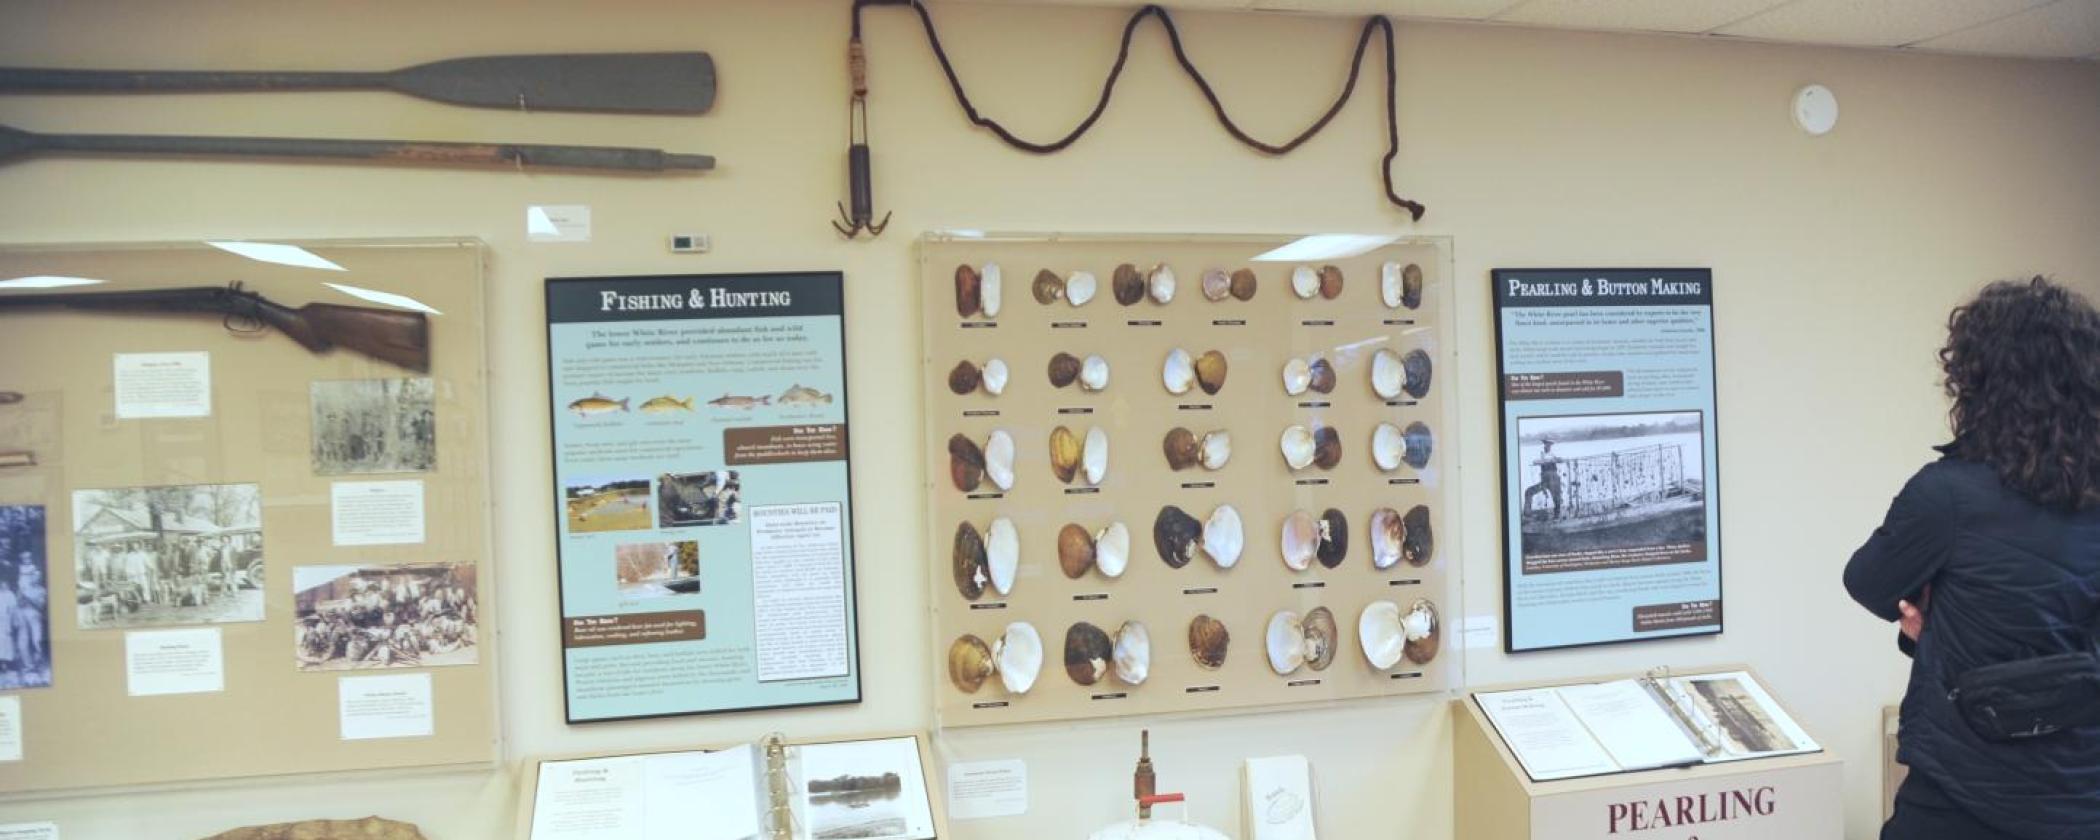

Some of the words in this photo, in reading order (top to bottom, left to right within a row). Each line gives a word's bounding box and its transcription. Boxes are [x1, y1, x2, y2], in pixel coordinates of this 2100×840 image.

[600, 290, 683, 311] FISHING
[688, 288, 704, 309] &
[710, 287, 791, 308] HUNTING
[1508, 279, 1577, 297] PEARLING
[1581, 279, 1593, 296] &
[1598, 278, 1648, 295] BUTTON
[1651, 278, 1701, 295] MAKING
[1607, 786, 1776, 834] PEARLING
